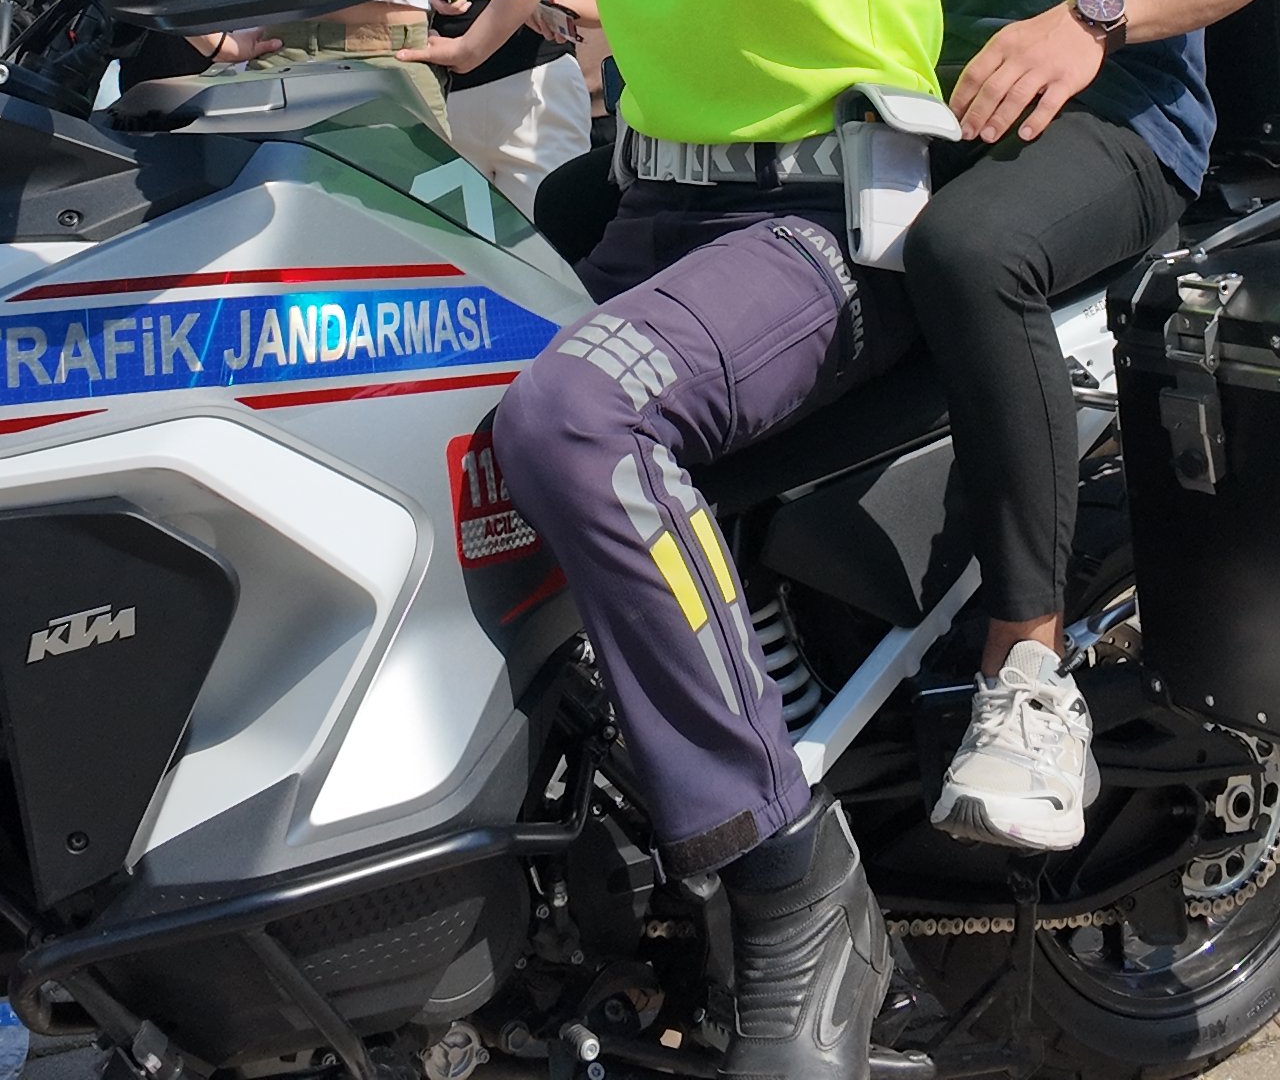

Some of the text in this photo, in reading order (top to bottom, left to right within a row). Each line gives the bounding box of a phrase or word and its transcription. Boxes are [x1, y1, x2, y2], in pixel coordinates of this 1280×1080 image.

[224, 299, 493, 374] JANDARMASI
[461, 447, 510, 509] 11
[26, 603, 137, 665] KTM
